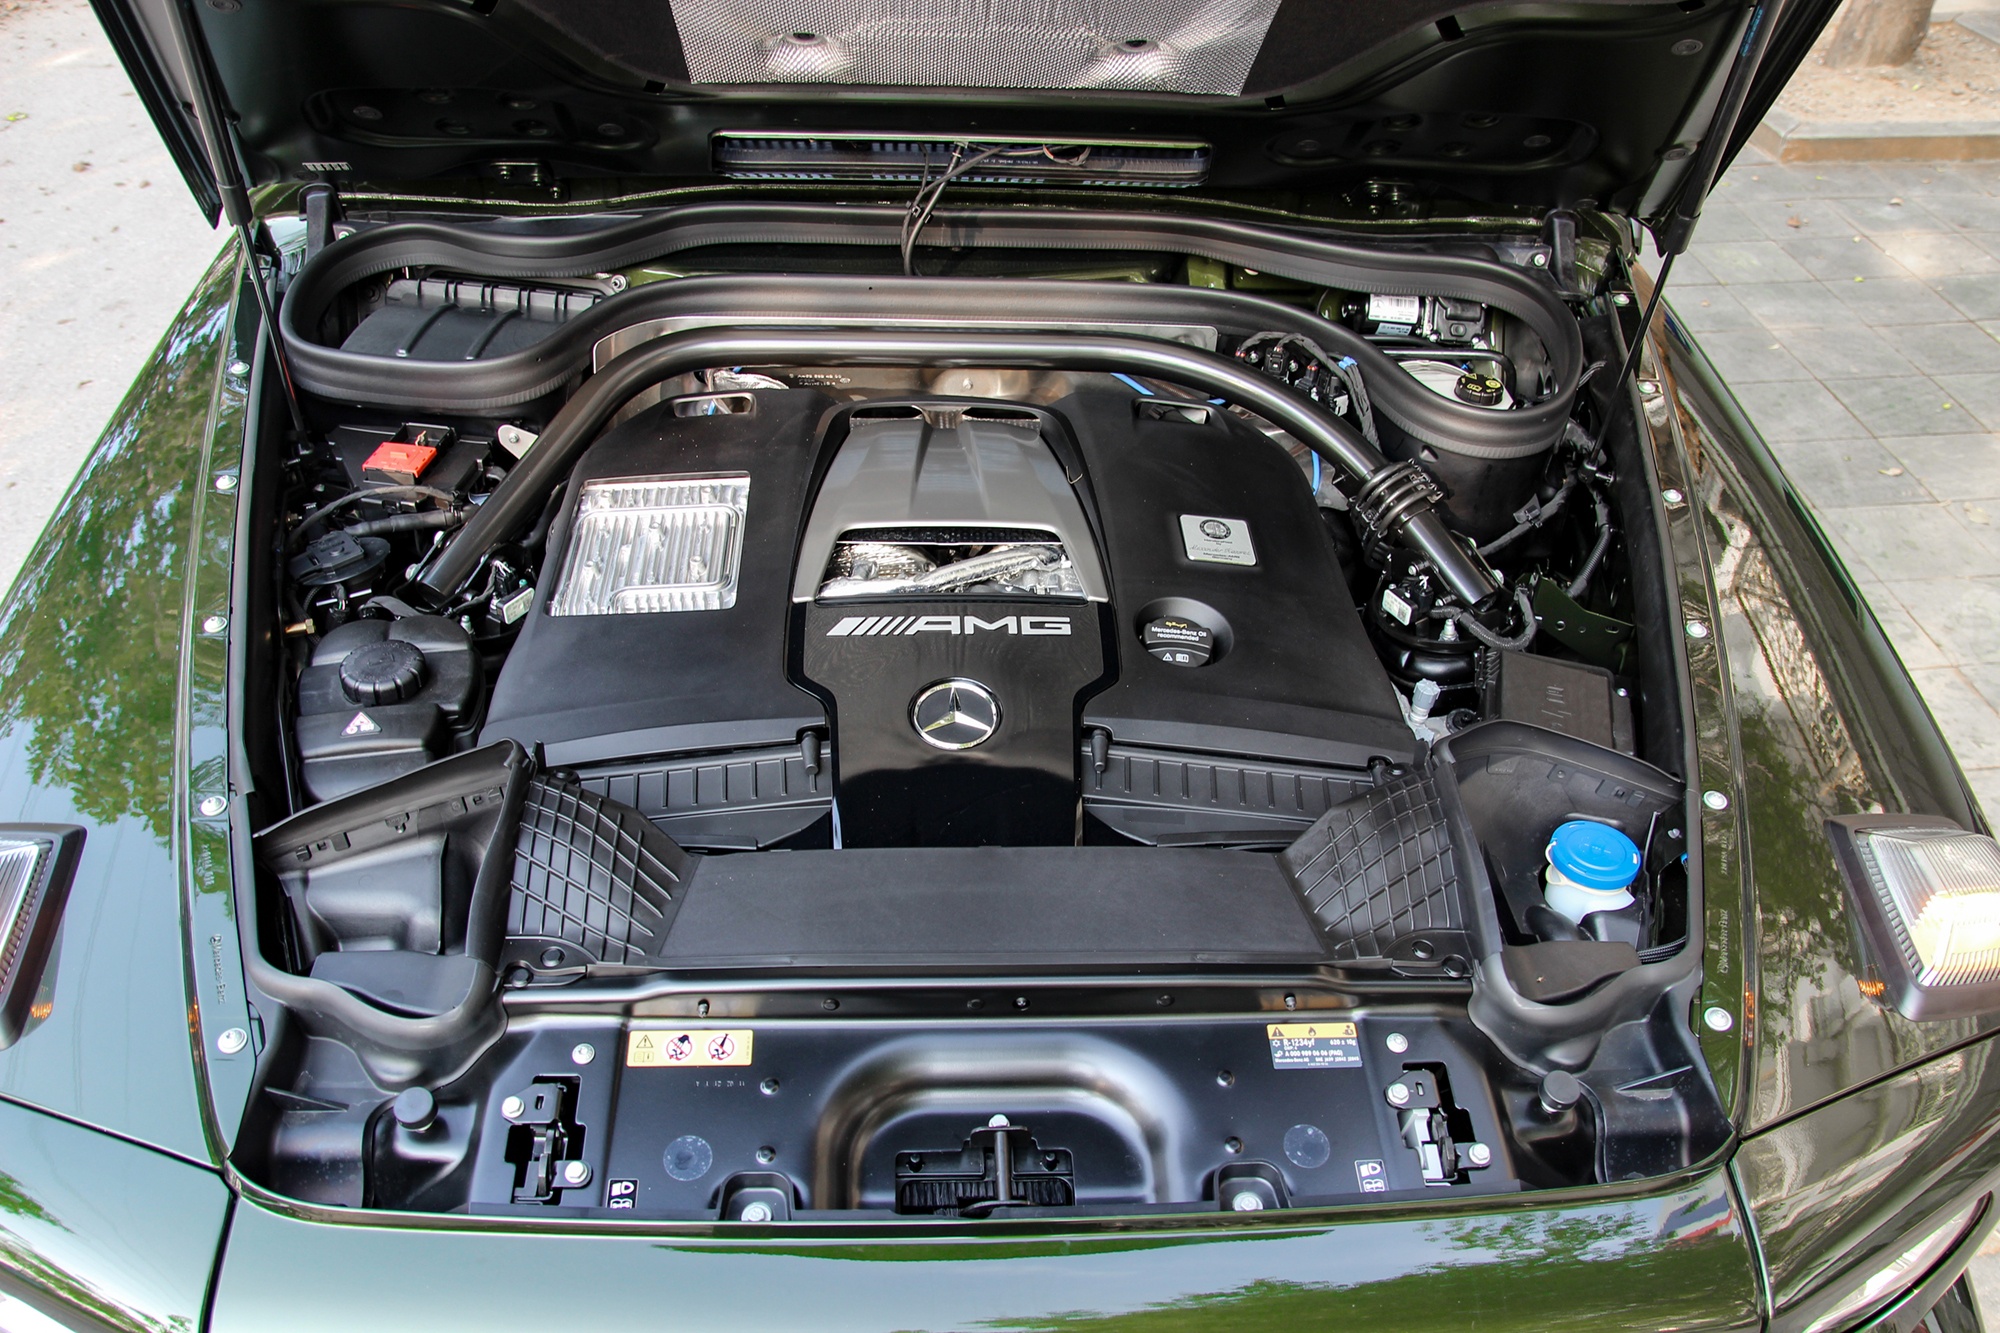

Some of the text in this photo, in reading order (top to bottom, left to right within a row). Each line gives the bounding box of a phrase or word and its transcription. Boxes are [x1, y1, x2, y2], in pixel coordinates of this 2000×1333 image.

[1151, 626, 1197, 636] Mercedes-Benz
[1157, 632, 1199, 641] recommended
[1283, 1038, 1315, 1047] R-1234yf
